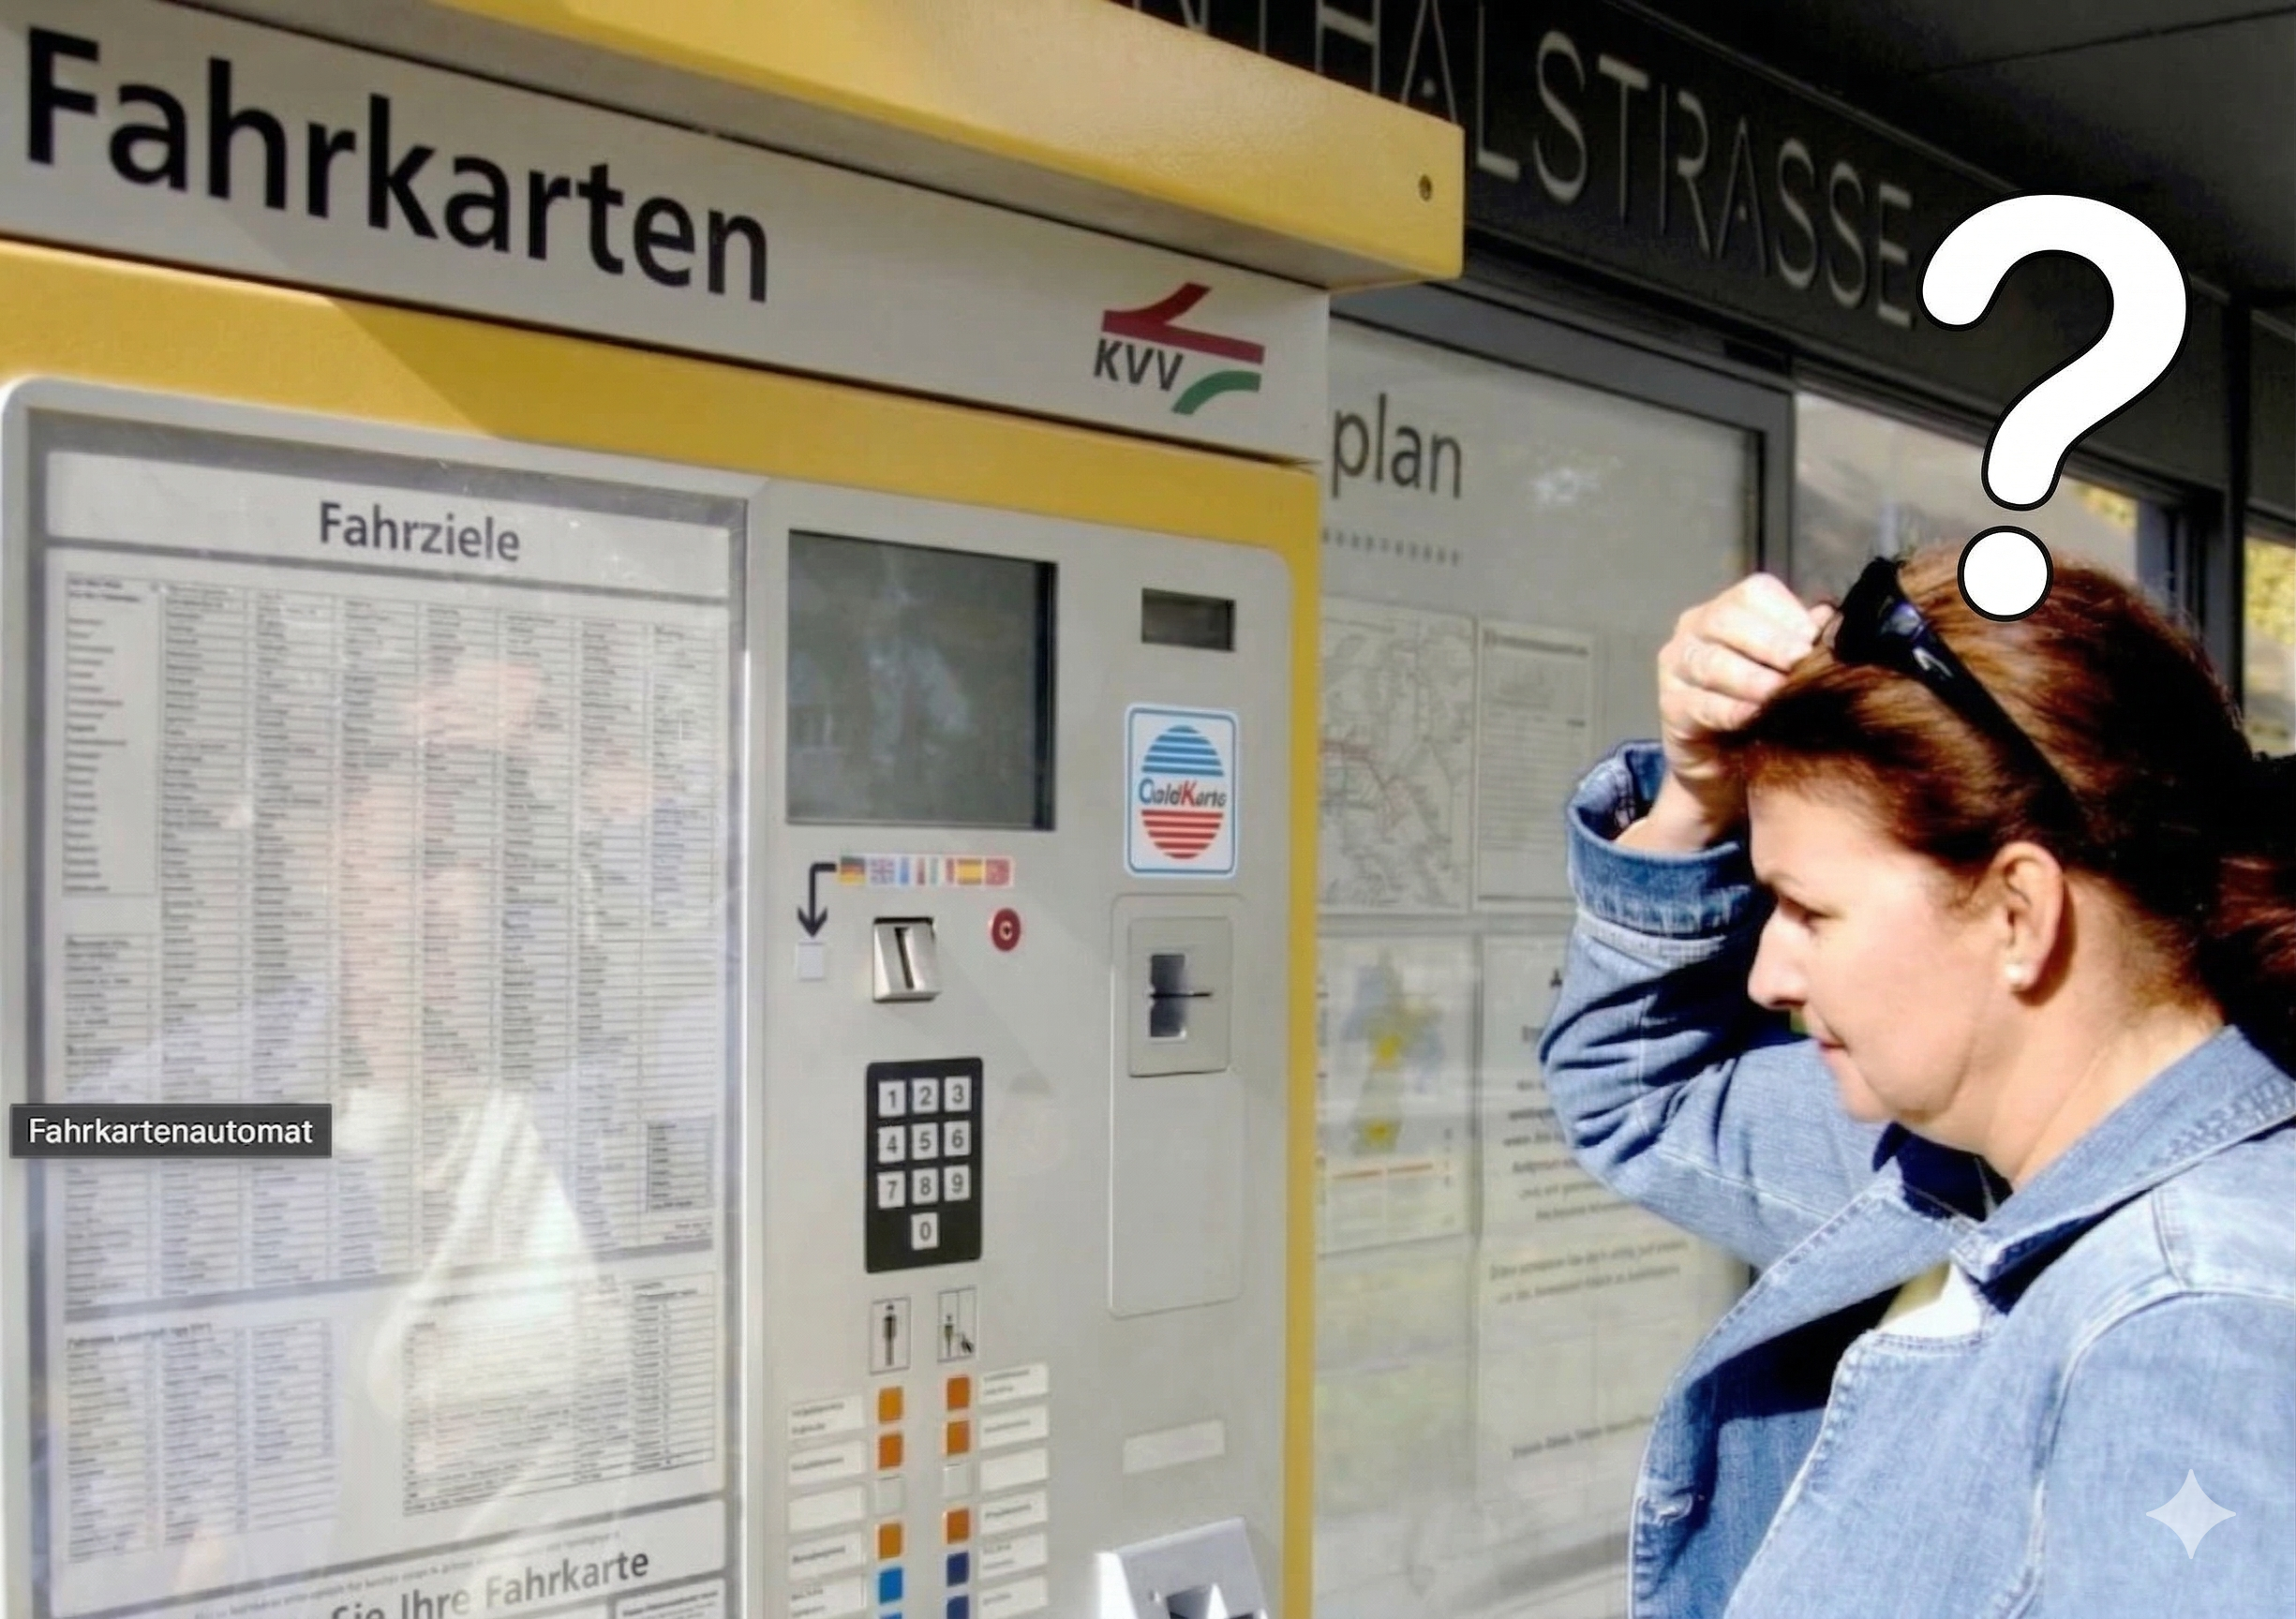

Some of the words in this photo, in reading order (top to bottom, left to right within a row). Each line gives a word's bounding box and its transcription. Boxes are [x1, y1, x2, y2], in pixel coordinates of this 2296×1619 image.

[29, 26, 768, 303] Fahrkarten
[1135, 0, 1915, 329] HALSTRASSE
[1094, 338, 1184, 392] KVV
[1333, 392, 1461, 499] plan
[321, 501, 520, 562] Fahrziele
[887, 1090, 897, 1108] 1
[919, 1086, 932, 1107] 2
[952, 1083, 964, 1105] 3
[887, 1135, 898, 1154] 4
[919, 1130, 932, 1151] 5
[951, 1128, 964, 1149] 6
[887, 1180, 898, 1200] 7
[919, 1176, 932, 1196] 8
[951, 1172, 964, 1195] 9
[919, 1221, 932, 1241] 0
[401, 1589, 470, 1619] Ihre
[485, 1552, 649, 1610] Fahrkarte
